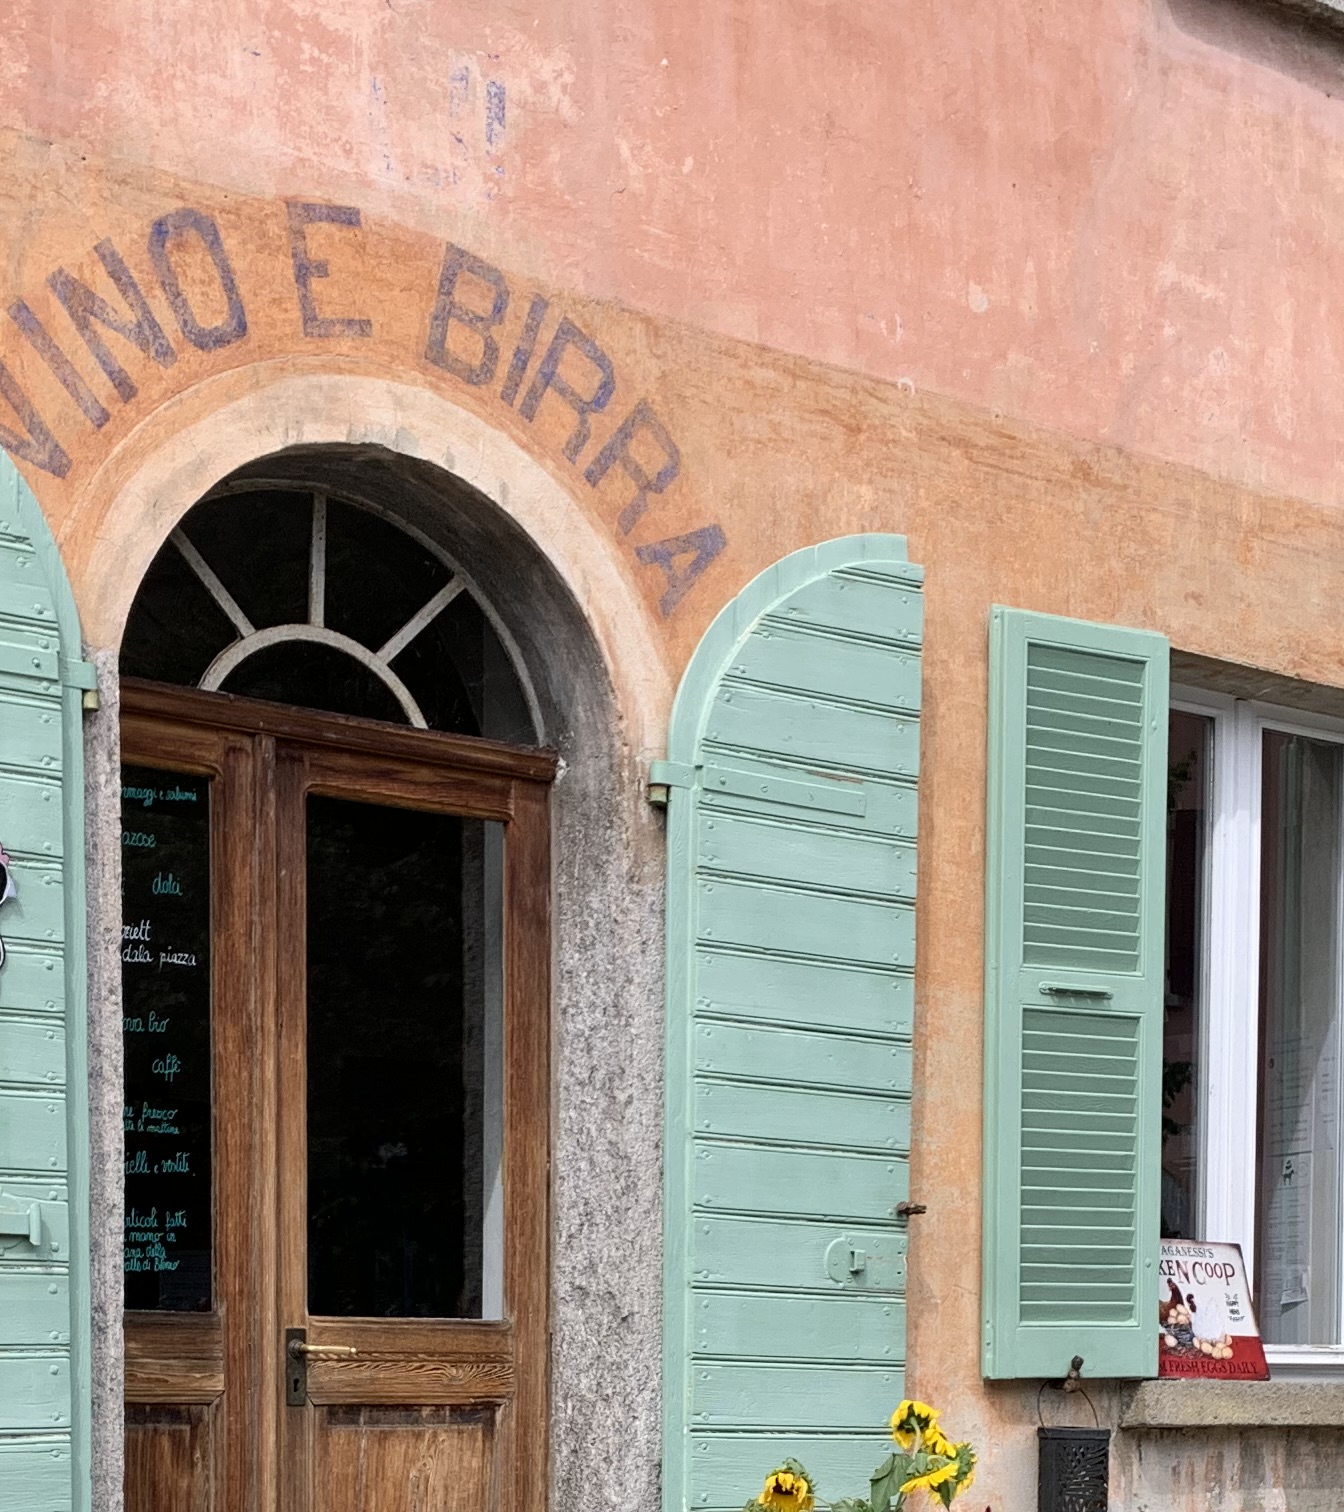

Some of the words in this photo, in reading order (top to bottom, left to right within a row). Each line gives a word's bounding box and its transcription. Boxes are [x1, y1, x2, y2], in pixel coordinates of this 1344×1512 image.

[286, 201, 372, 338] E
[425, 240, 727, 617] BIRRA
[122, 831, 156, 848] azose
[159, 945, 197, 973] piazza
[122, 1017, 145, 1032] ova
[1161, 1246, 1215, 1259] AGANESSI'S
[1158, 1259, 1191, 1285] KEN
[1192, 1261, 1235, 1286] COOP
[1169, 1360, 1199, 1374] FRESH
[1200, 1360, 1226, 1374] EGGS
[1227, 1361, 1258, 1375] DAILY
